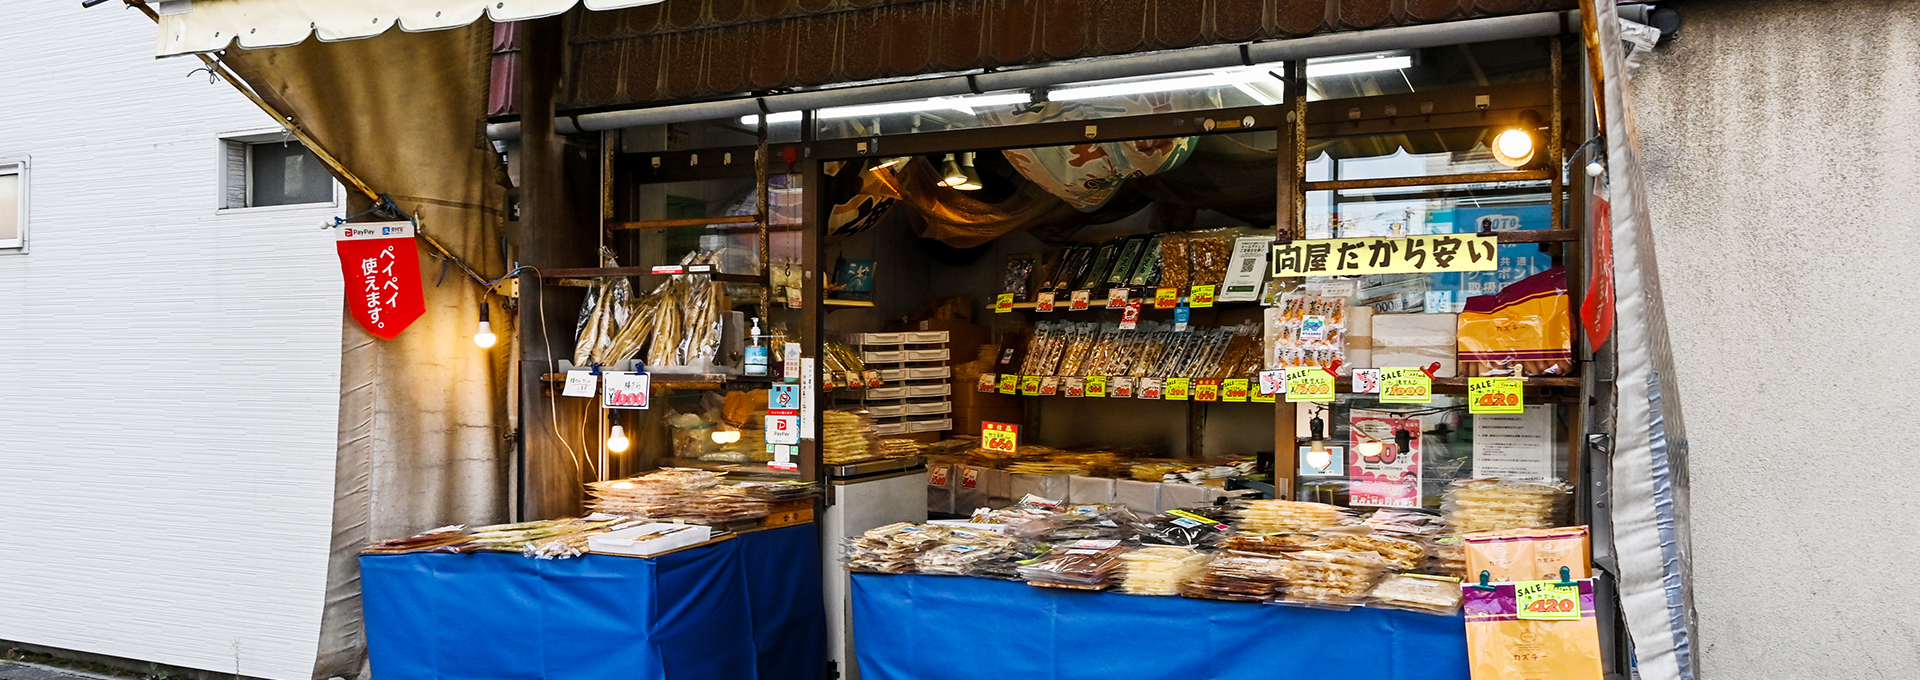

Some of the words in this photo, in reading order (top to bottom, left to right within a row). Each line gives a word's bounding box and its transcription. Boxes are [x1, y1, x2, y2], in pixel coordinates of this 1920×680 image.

[1490, 217, 1517, 229] OTO
[1275, 236, 1495, 274] 問屋だから安い
[380, 245, 399, 308] ペイペイ
[361, 257, 385, 329] 使えます。
[1287, 369, 1310, 381] SALE!
[1381, 369, 1406, 381] SALE!
[1470, 379, 1496, 391] SALE!
[1474, 393, 1519, 406] ¥420
[1517, 582, 1547, 597] SALE!
[1523, 599, 1575, 612] ¥420
[1514, 652, 1550, 661] カズチー
